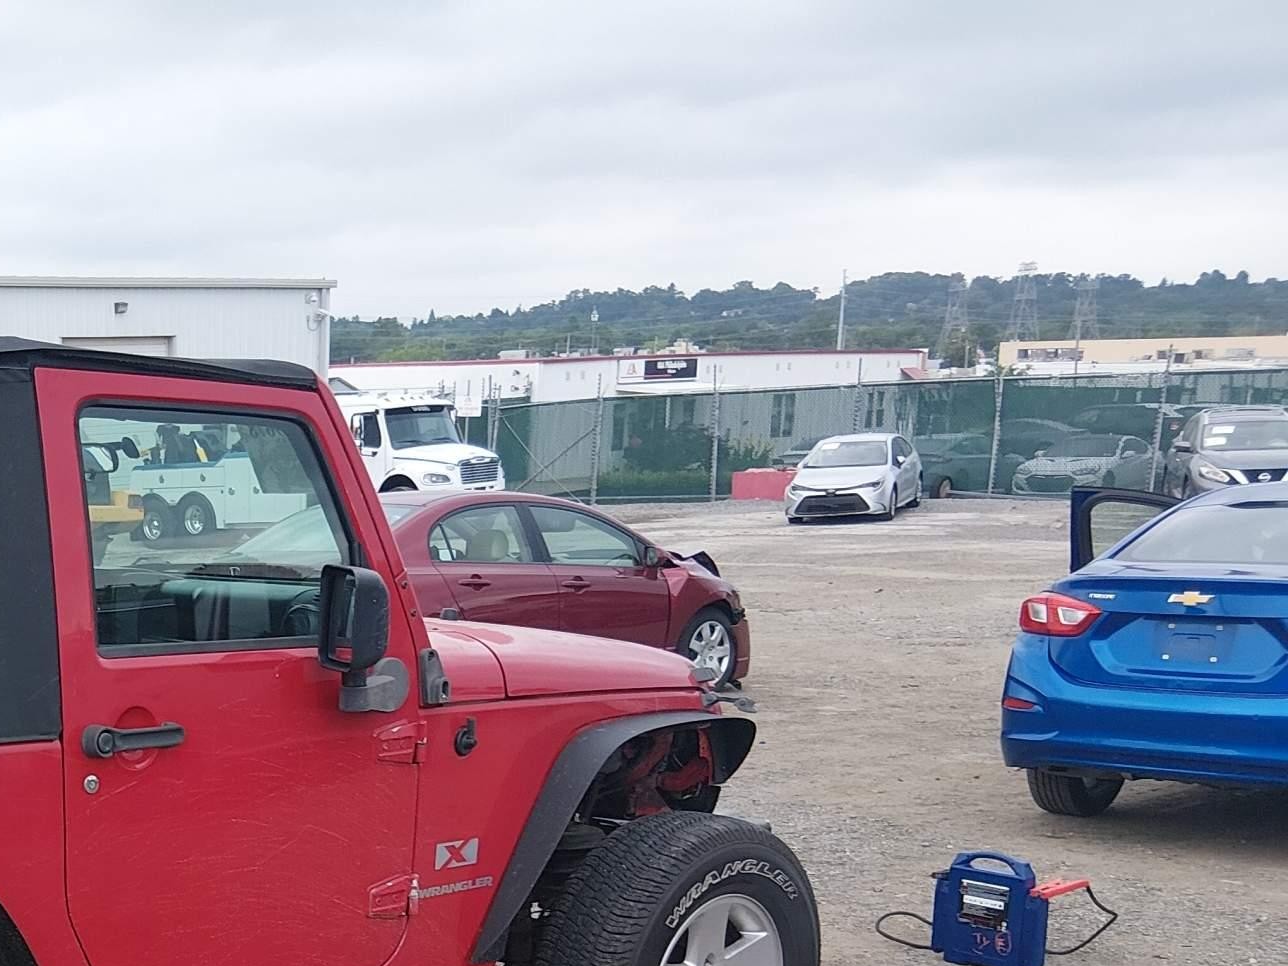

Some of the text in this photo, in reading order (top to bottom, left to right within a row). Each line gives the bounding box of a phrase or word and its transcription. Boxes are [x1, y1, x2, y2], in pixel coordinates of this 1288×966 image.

[436, 838, 477, 870] X
[418, 876, 493, 899] WRANGLER
[665, 858, 798, 928] WRANGLER
